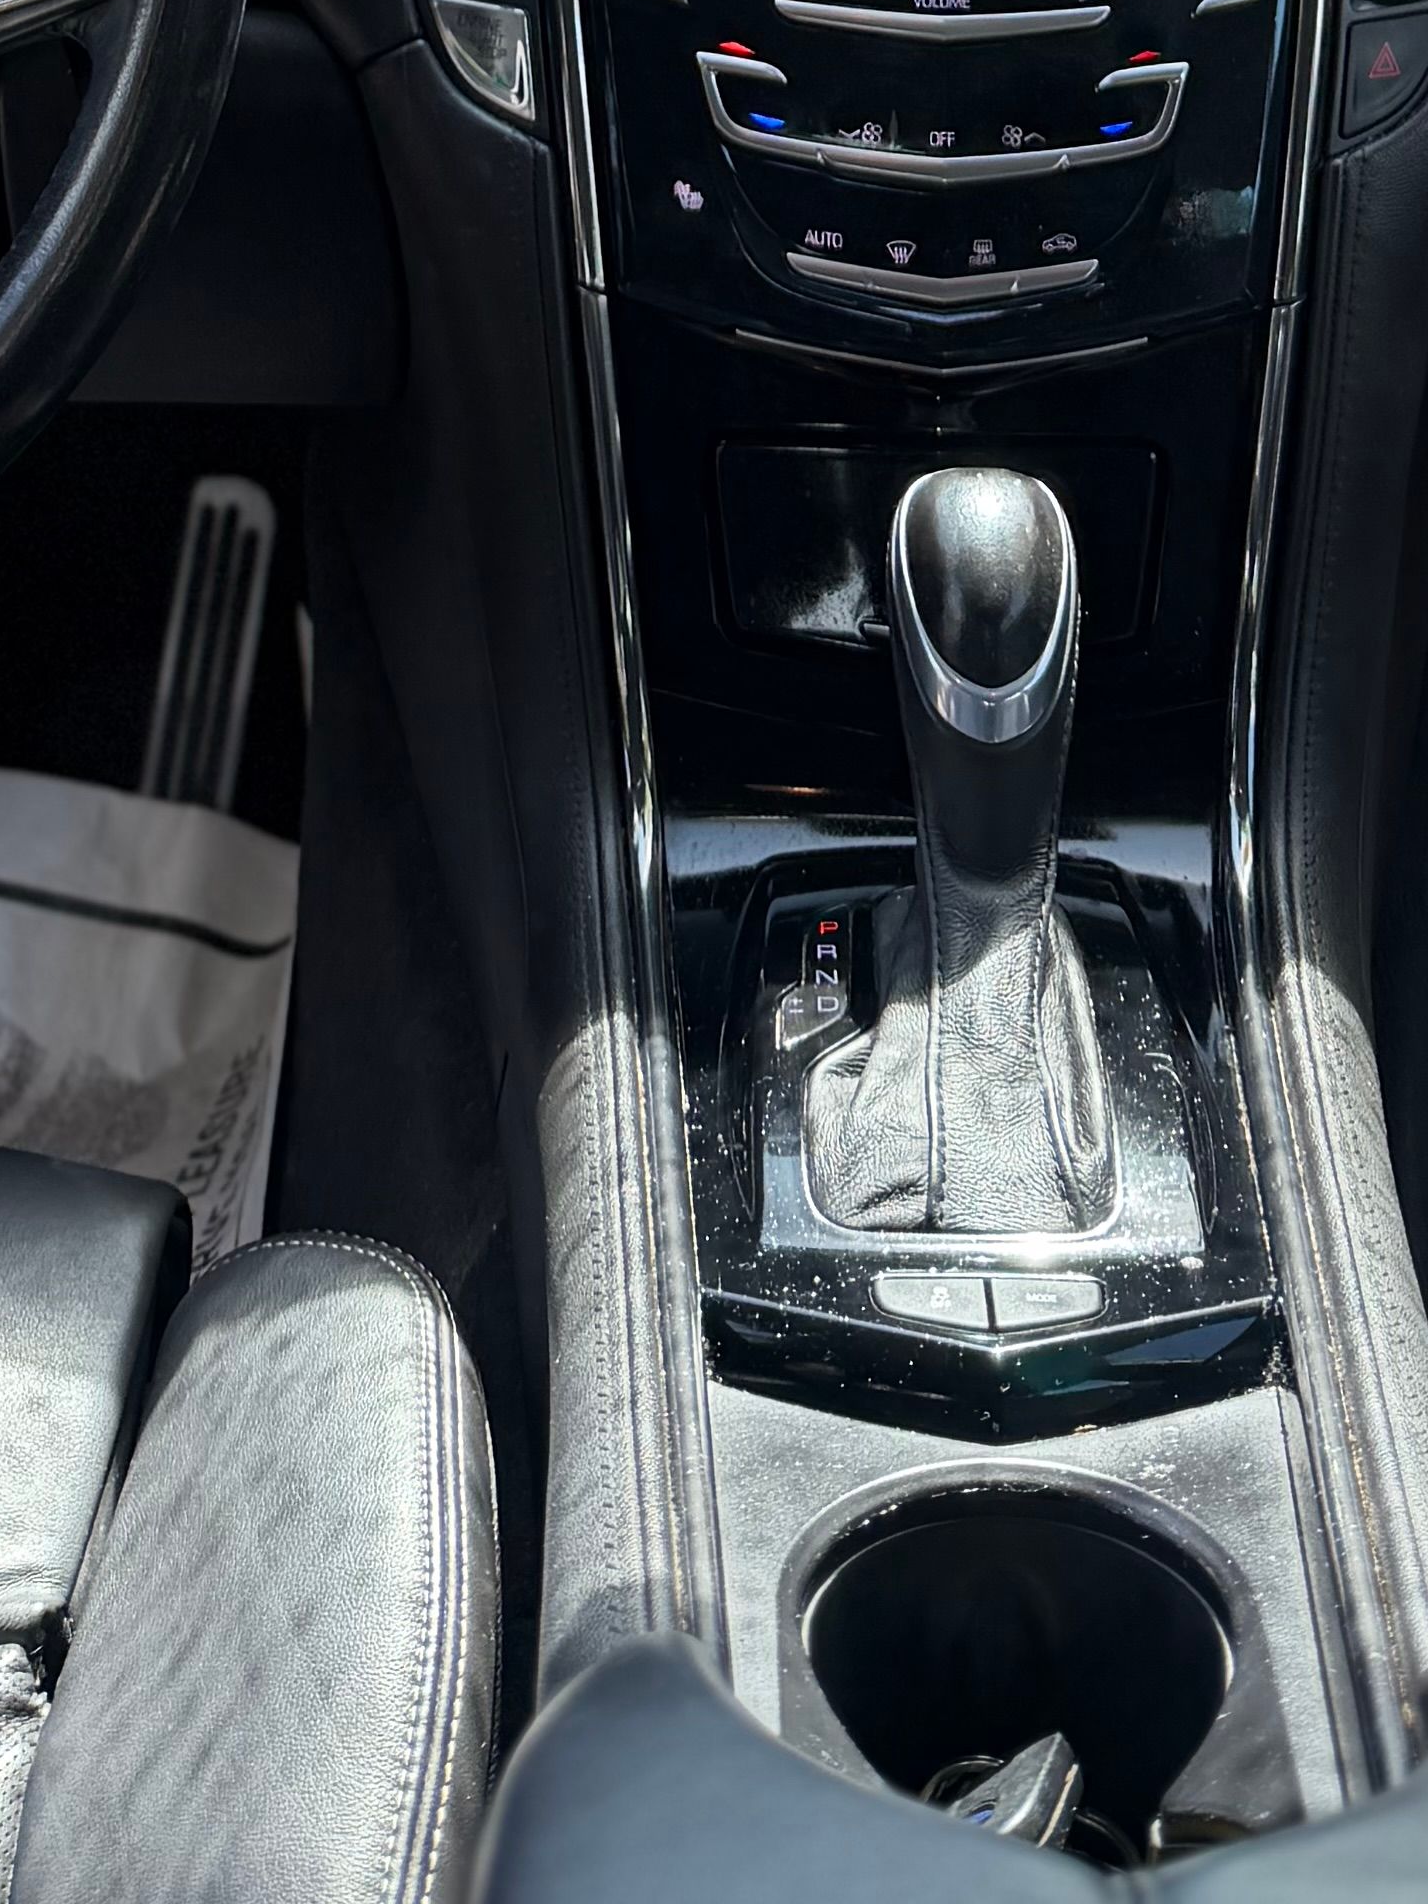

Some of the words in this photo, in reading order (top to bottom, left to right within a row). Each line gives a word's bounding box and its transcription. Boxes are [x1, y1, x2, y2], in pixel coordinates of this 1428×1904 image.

[929, 130, 955, 146] OFF
[805, 229, 843, 249] AUTO
[969, 254, 996, 265] REAR
[820, 921, 839, 935] P
[817, 944, 837, 959] R
[816, 969, 838, 985] N
[817, 996, 839, 1012] D
[1026, 1292, 1058, 1303] MODE
